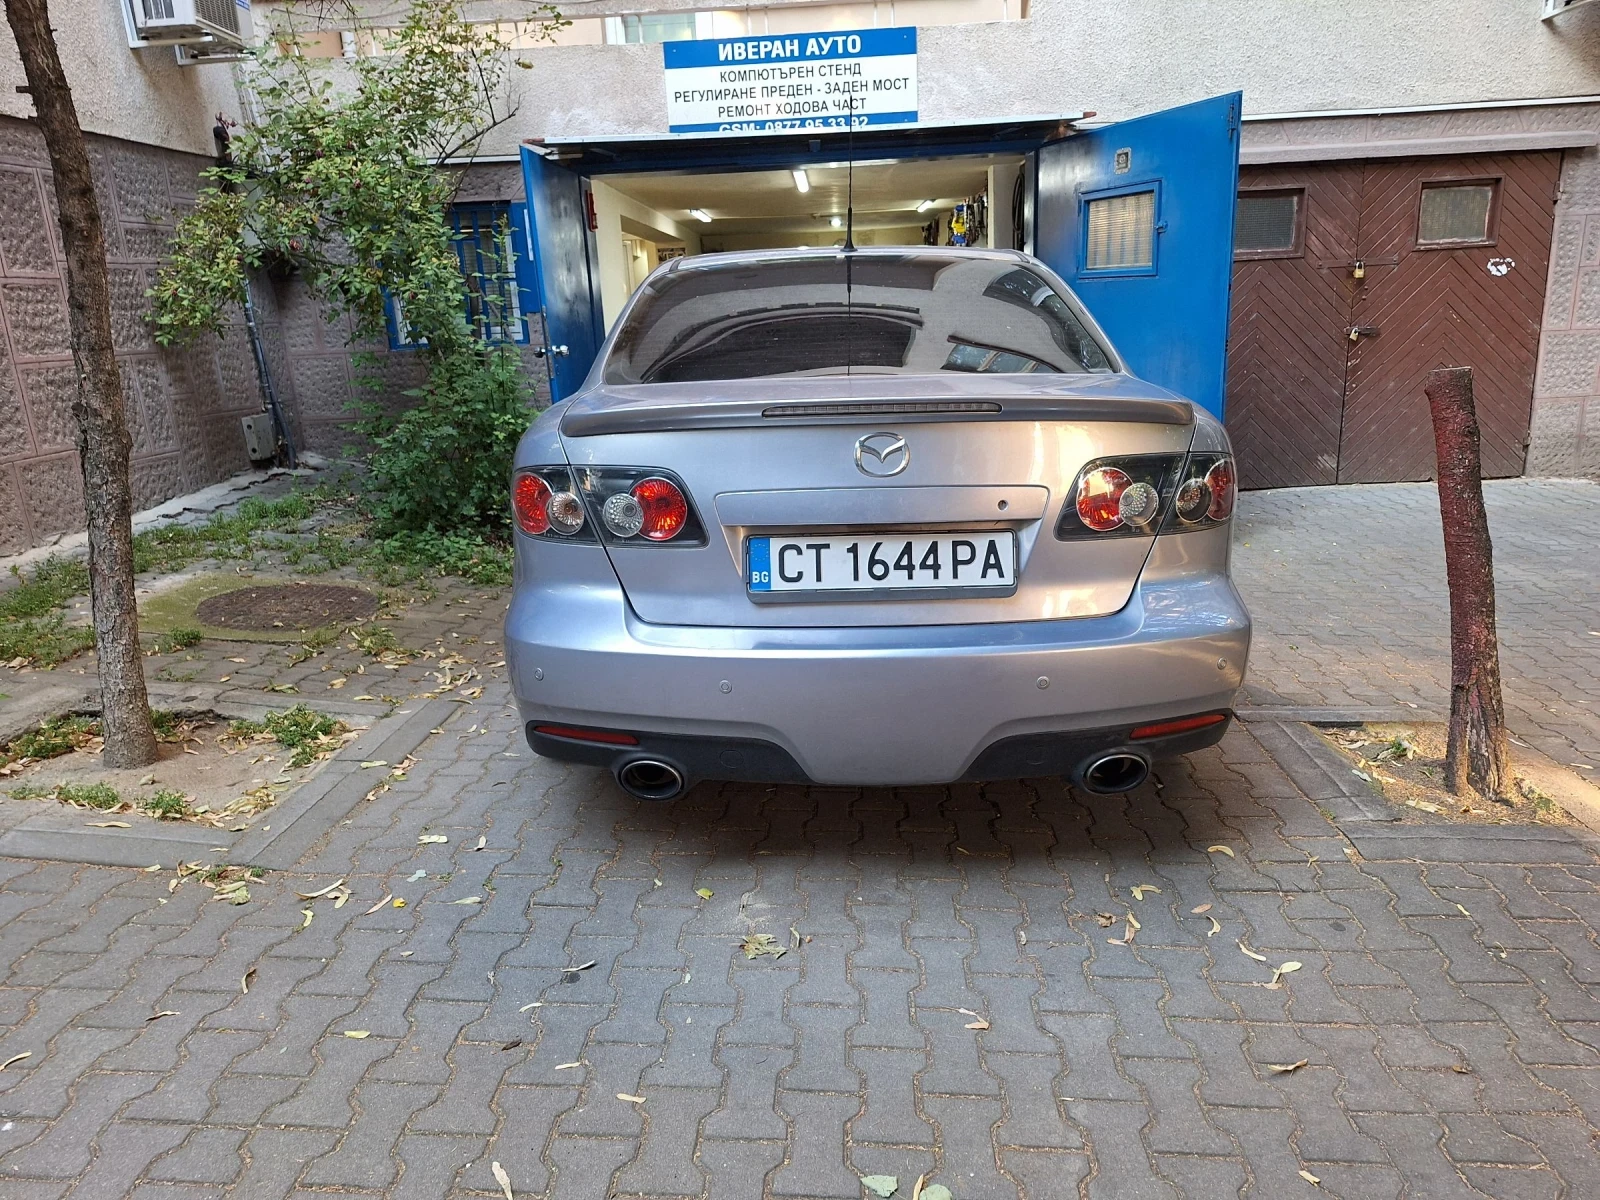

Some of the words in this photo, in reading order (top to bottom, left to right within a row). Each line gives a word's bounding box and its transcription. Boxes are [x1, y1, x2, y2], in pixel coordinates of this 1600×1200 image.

[718, 38, 799, 61] ИВЕРАН
[805, 34, 861, 56] АУТО
[720, 66, 814, 83] КОМПЮТЪРЕН
[818, 62, 862, 77] СТЕНД
[674, 86, 757, 103] РЕГУЛИРАНЕ
[761, 83, 813, 99] ПРЕДЕН
[824, 80, 868, 95] ЗАДЕН
[872, 77, 910, 92] МОСТ
[718, 103, 770, 118] РЕМОНТ
[775, 100, 829, 116] ХОДОВА
[832, 97, 867, 111] ЧАСТ
[778, 543, 831, 582] CT
[752, 571, 769, 584] BG
